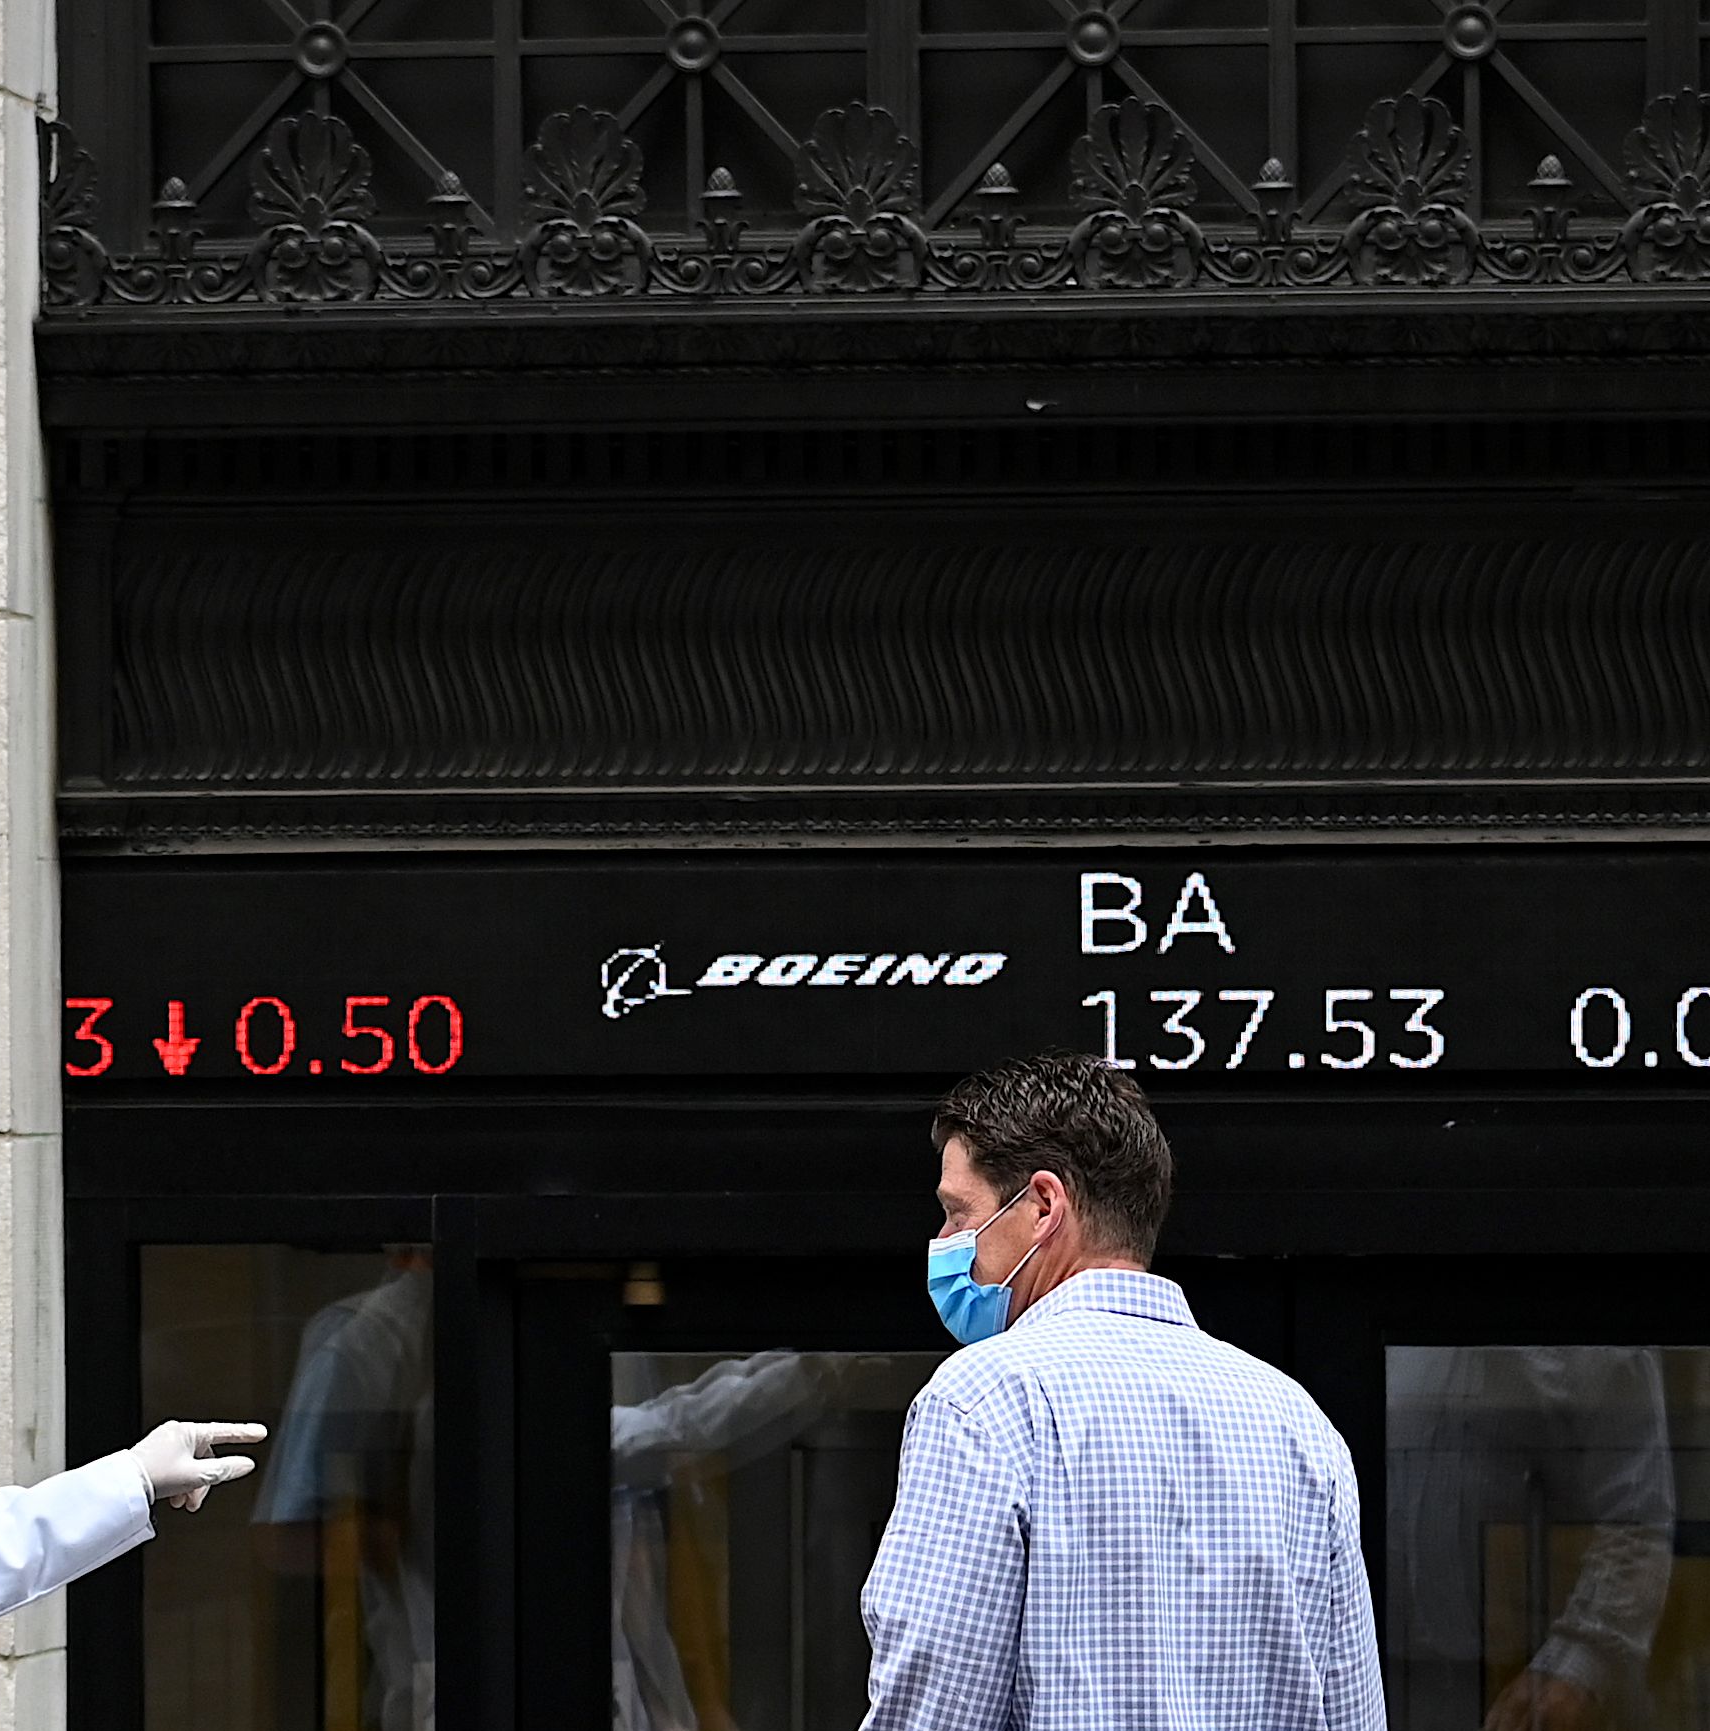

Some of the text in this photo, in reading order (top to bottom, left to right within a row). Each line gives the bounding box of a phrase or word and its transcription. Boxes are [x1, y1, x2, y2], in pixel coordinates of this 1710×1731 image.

[1081, 872, 1236, 954] BA
[234, 995, 463, 1075] 0.50
[1081, 989, 1444, 1069] 137.53
